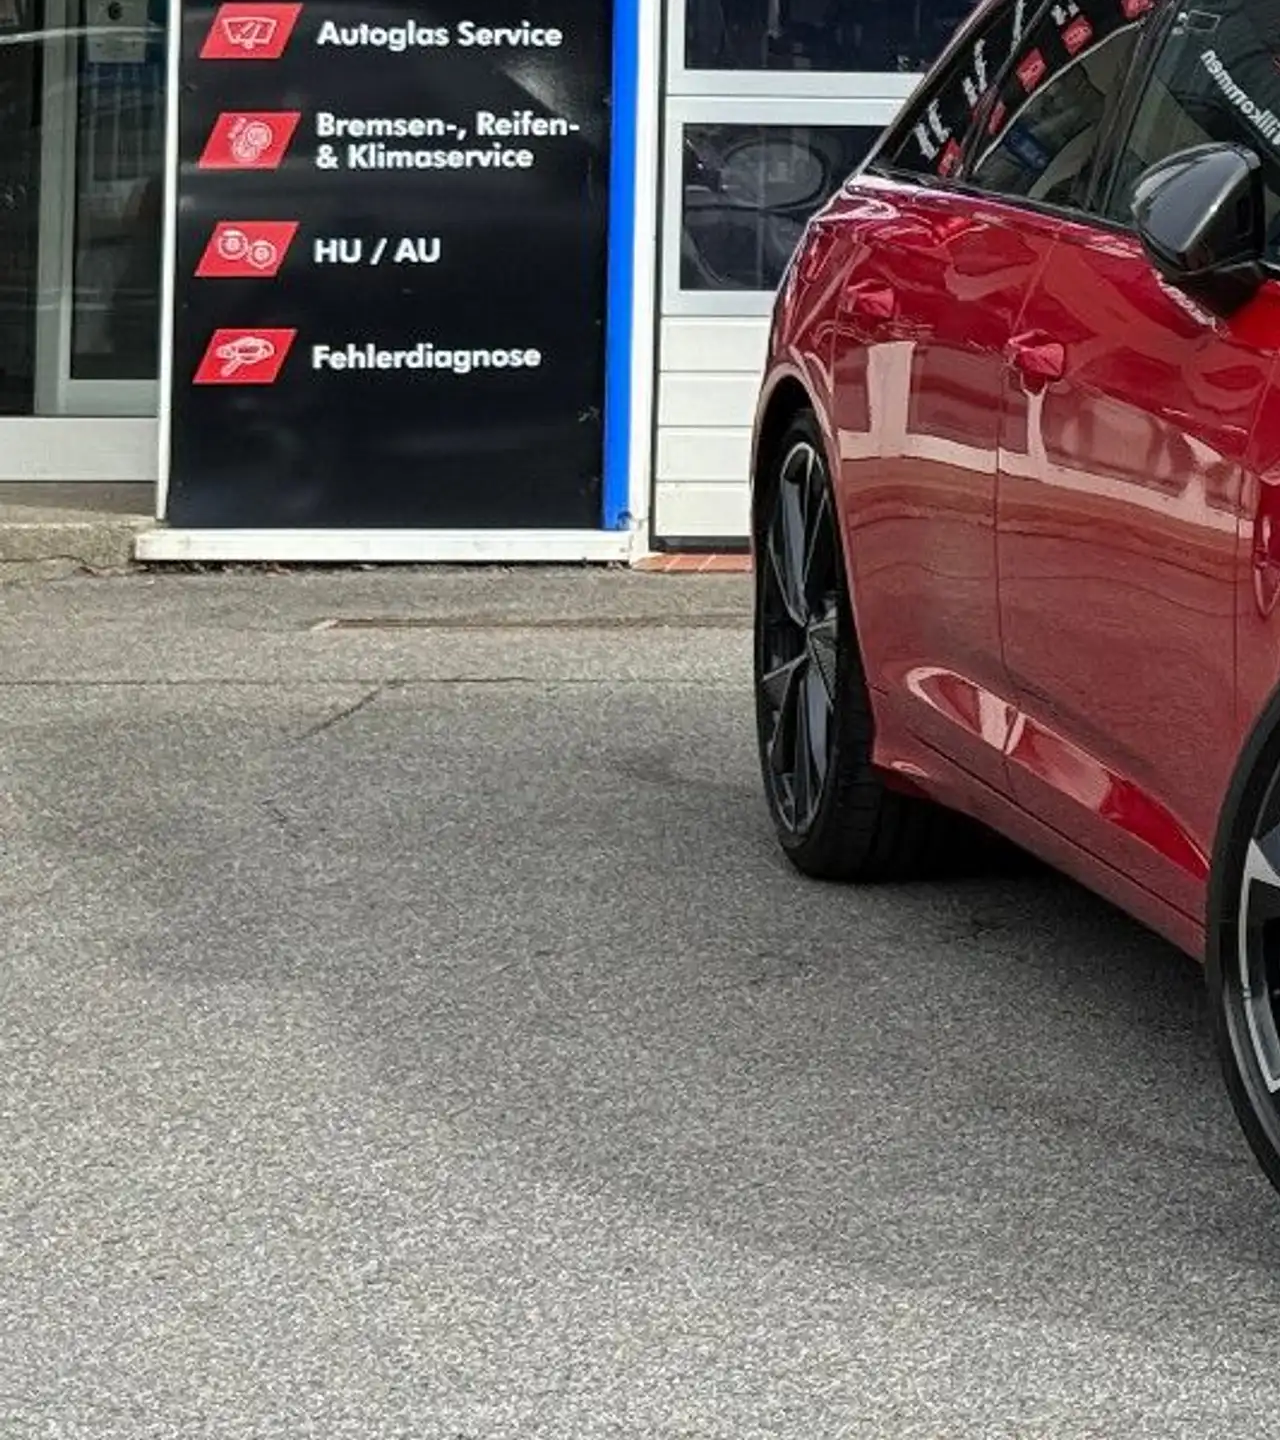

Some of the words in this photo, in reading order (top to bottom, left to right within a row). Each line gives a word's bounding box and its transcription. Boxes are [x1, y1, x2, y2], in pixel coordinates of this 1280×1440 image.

[316, 19, 450, 52] Autoglas
[457, 20, 563, 47] Service
[476, 110, 580, 136] Reifen-
[315, 143, 339, 169] &
[347, 141, 534, 169] Klimaservice
[314, 238, 362, 264] HU
[393, 237, 441, 263] AU
[312, 342, 542, 374] Fehlerdiagnose
